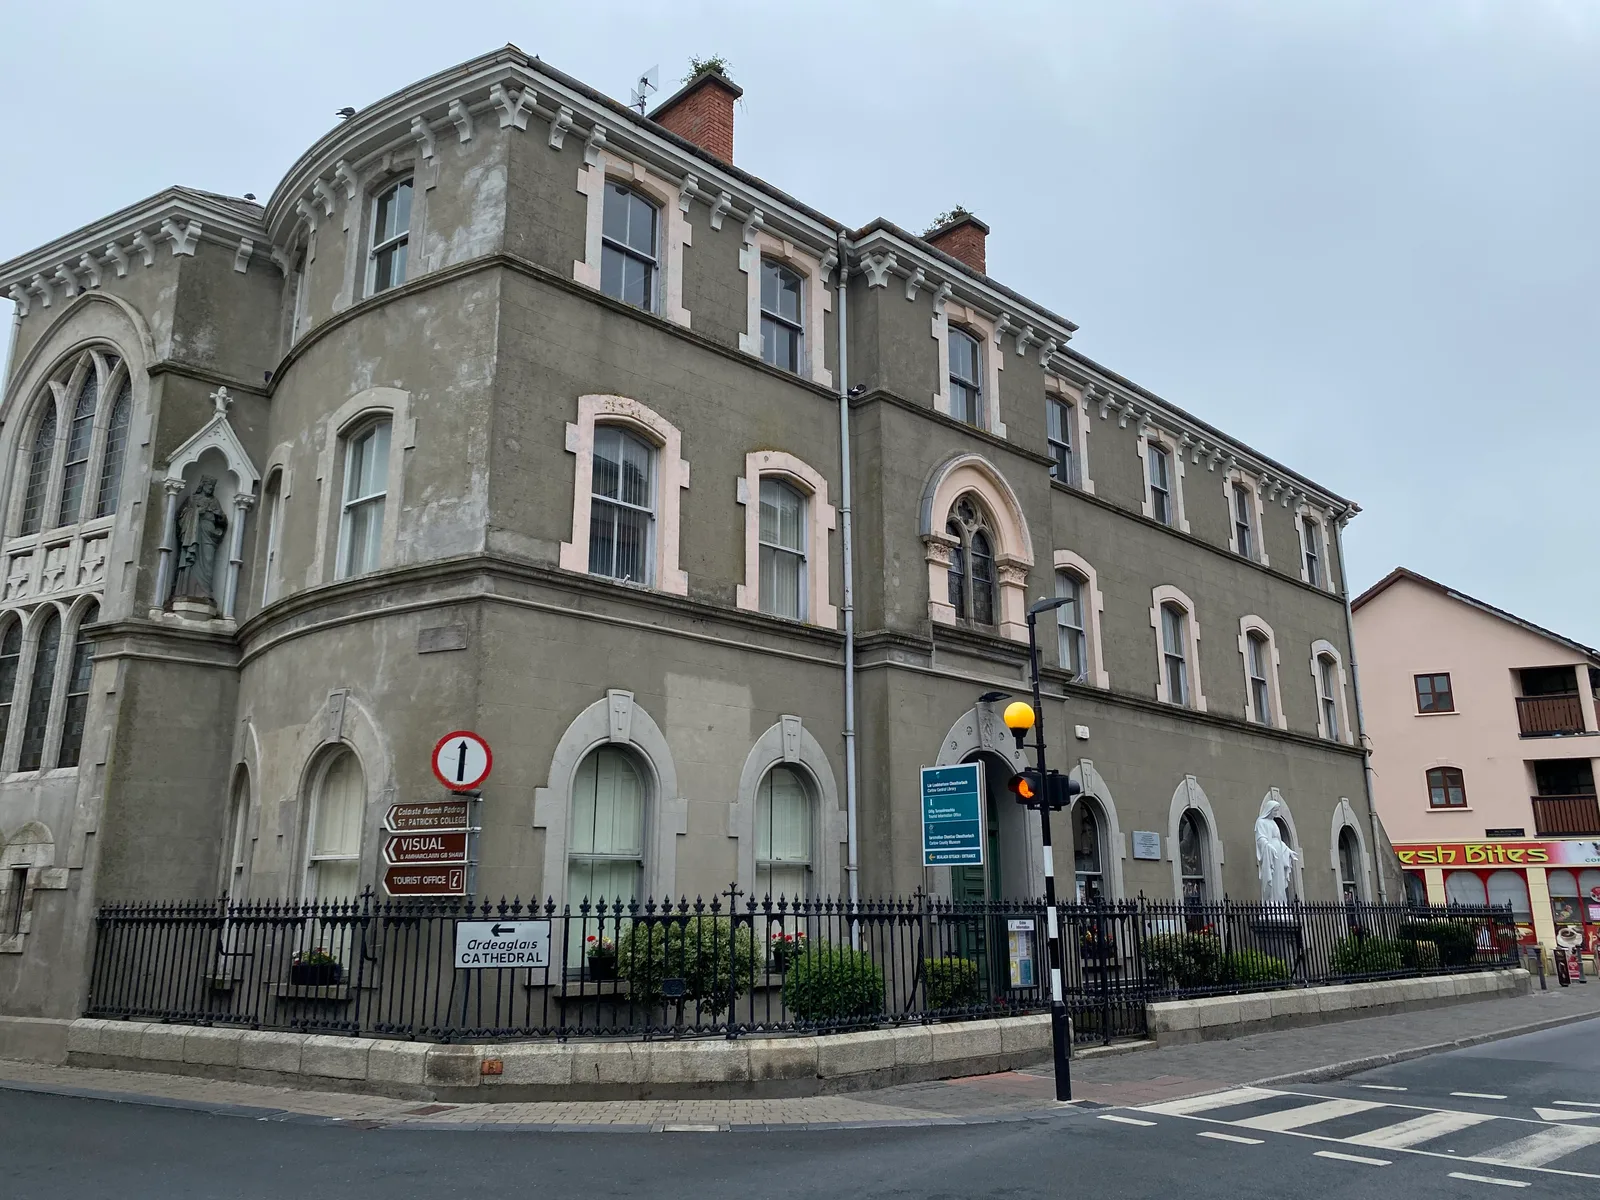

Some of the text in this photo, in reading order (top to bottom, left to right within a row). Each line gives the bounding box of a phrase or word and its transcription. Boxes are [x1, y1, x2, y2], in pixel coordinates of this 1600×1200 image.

[408, 817, 439, 826] PATRICK'S
[440, 815, 466, 825] COLLEGE
[401, 837, 445, 851] VISUAL
[1394, 844, 1549, 864] esh Bites
[393, 876, 421, 885] TOURIST
[422, 875, 446, 884] OFFICE
[461, 952, 543, 964] CATHEDRAL
